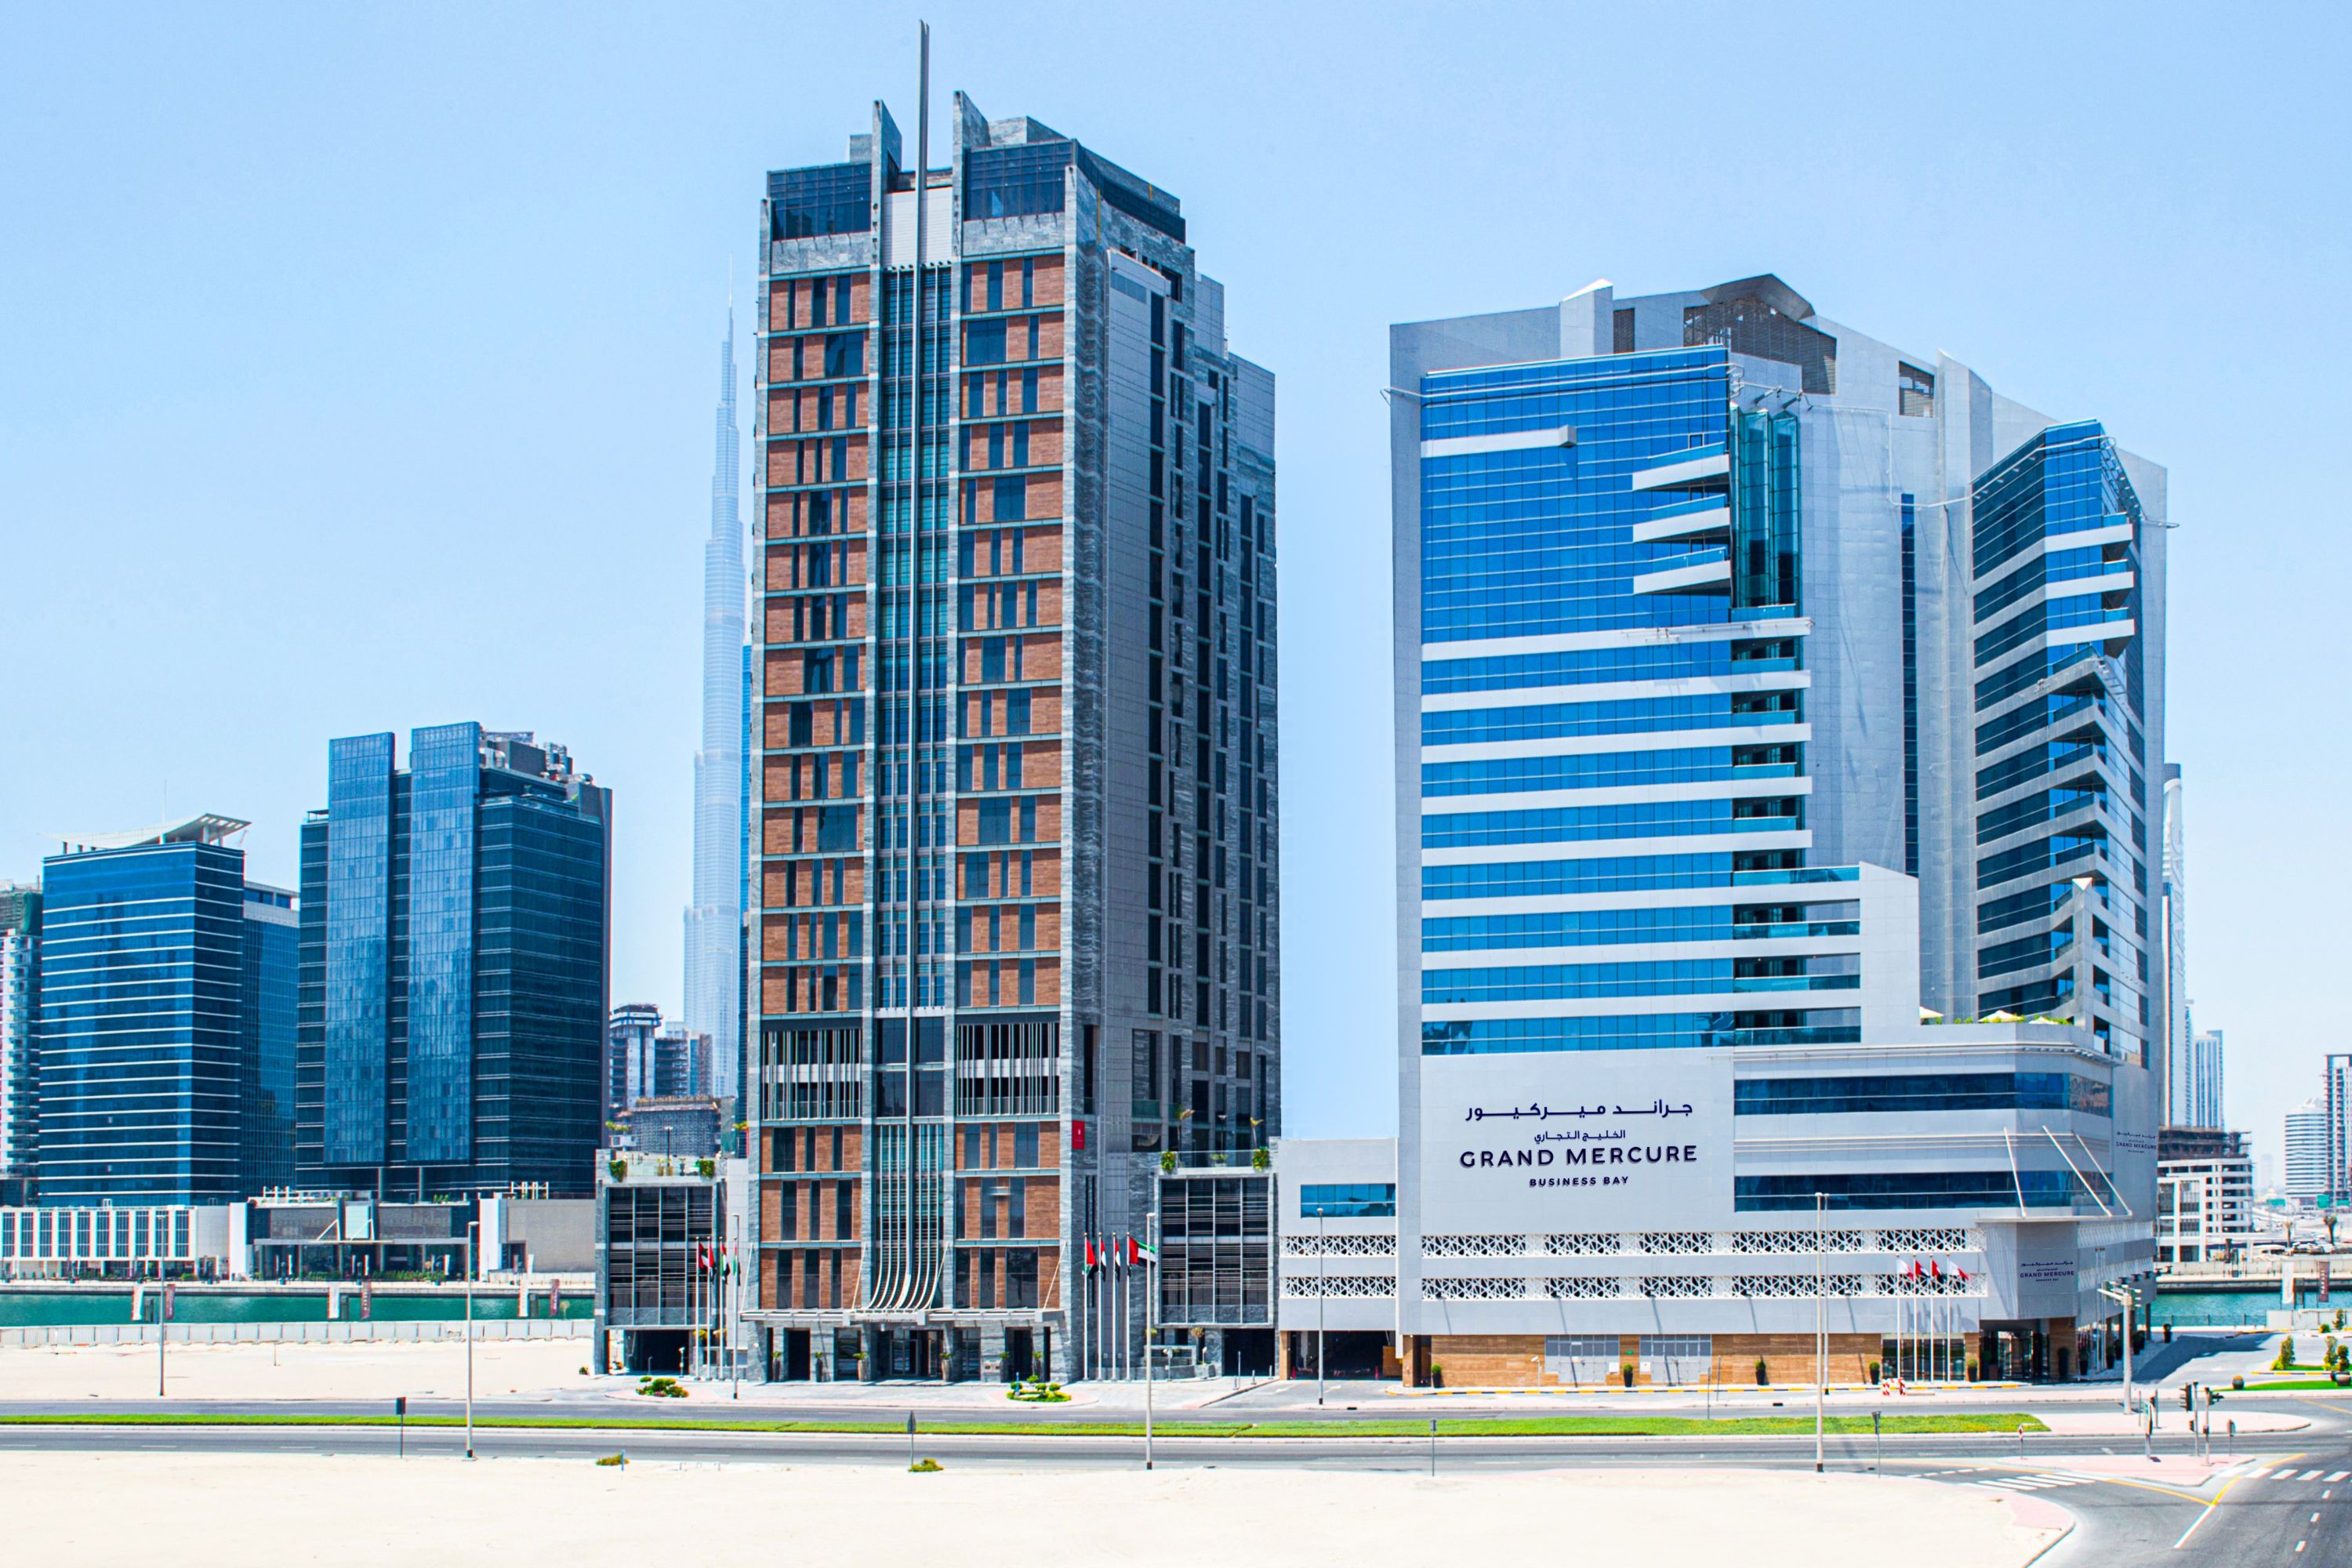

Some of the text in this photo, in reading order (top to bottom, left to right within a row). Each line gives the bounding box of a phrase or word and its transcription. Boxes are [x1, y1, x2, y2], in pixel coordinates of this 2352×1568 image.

[1465, 1098, 1693, 1121] جراند ميركيور
[1534, 1129, 1626, 1145] الخليج التجاري
[1460, 1145, 1698, 1168] GRAND MERCURE
[1530, 1175, 1629, 1188] BUSINESS BAY
